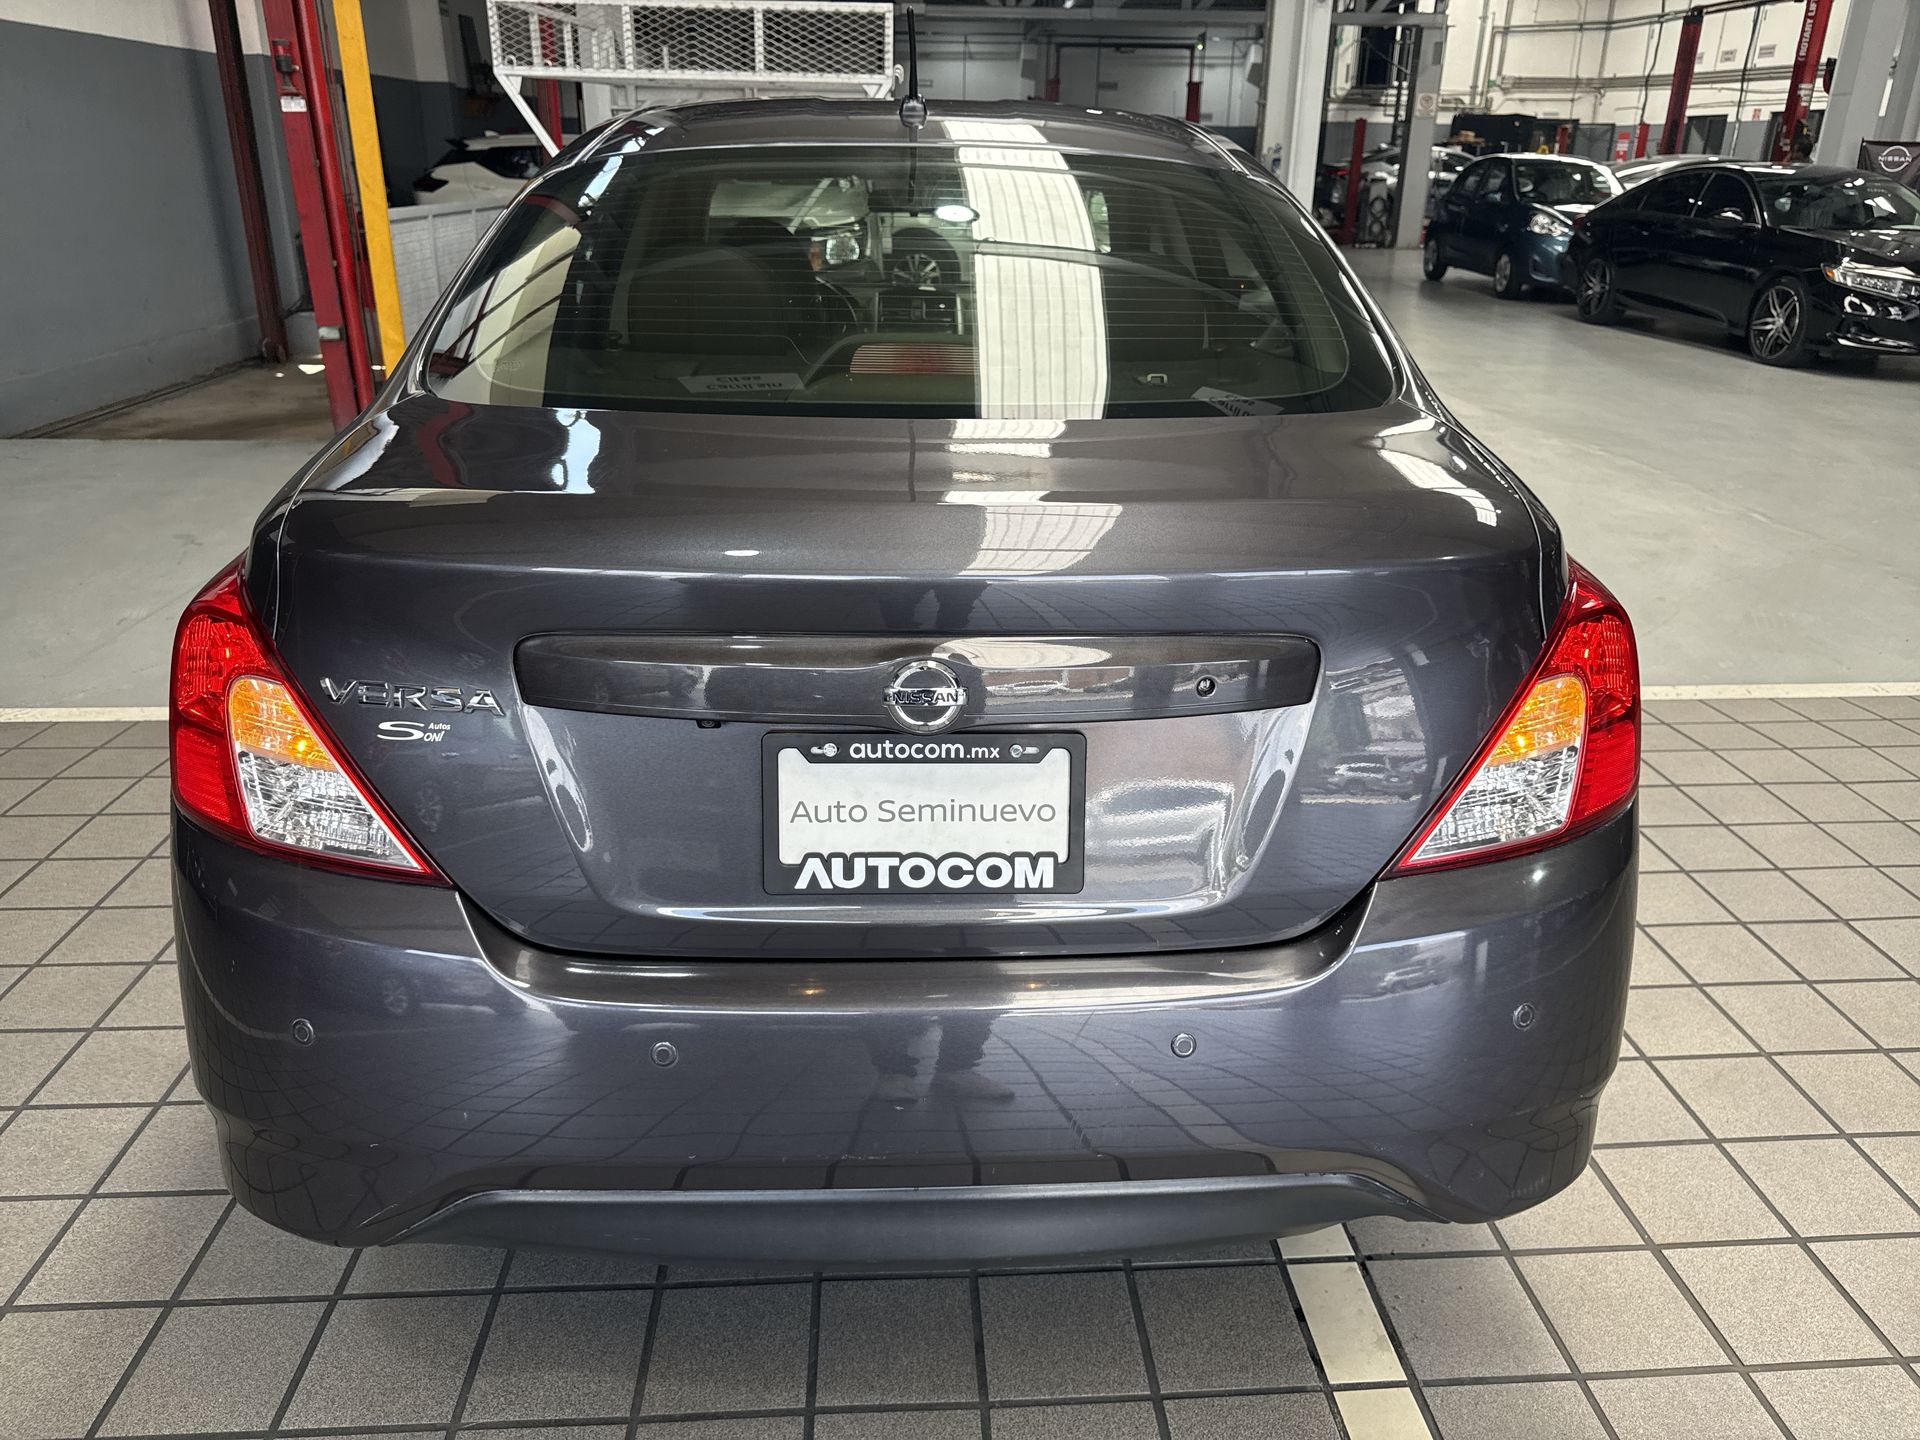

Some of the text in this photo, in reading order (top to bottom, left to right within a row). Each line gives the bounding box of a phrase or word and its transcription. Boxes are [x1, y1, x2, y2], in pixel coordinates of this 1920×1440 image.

[1799, 18, 1814, 57] ROTARY
[1878, 155, 1912, 163] NISSAN
[319, 677, 506, 717] VERSA
[892, 691, 959, 703] NISSAN
[428, 722, 451, 730] Autos
[849, 739, 1000, 759] autocom.mx
[789, 798, 1057, 824] Auto Seminuevo
[794, 856, 1055, 889] AUTOCOM
